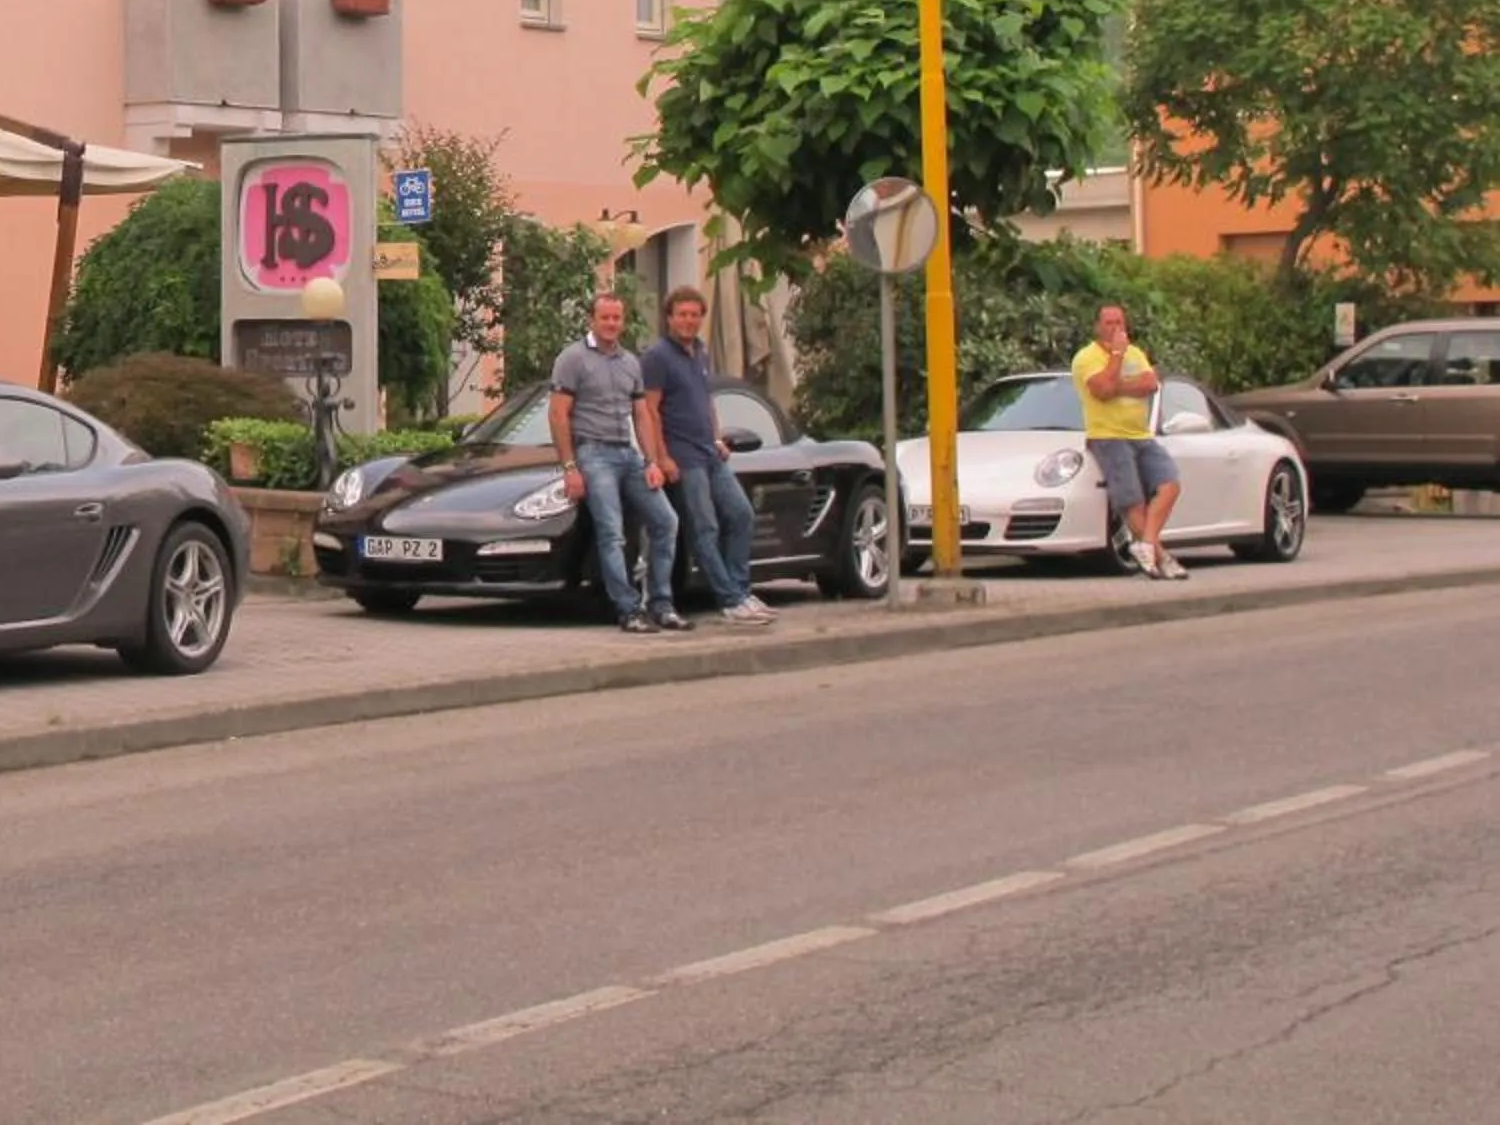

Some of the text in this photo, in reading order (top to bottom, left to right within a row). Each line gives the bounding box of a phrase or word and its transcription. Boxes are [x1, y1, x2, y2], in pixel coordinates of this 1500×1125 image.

[367, 538, 438, 557] GAP PZ 2
